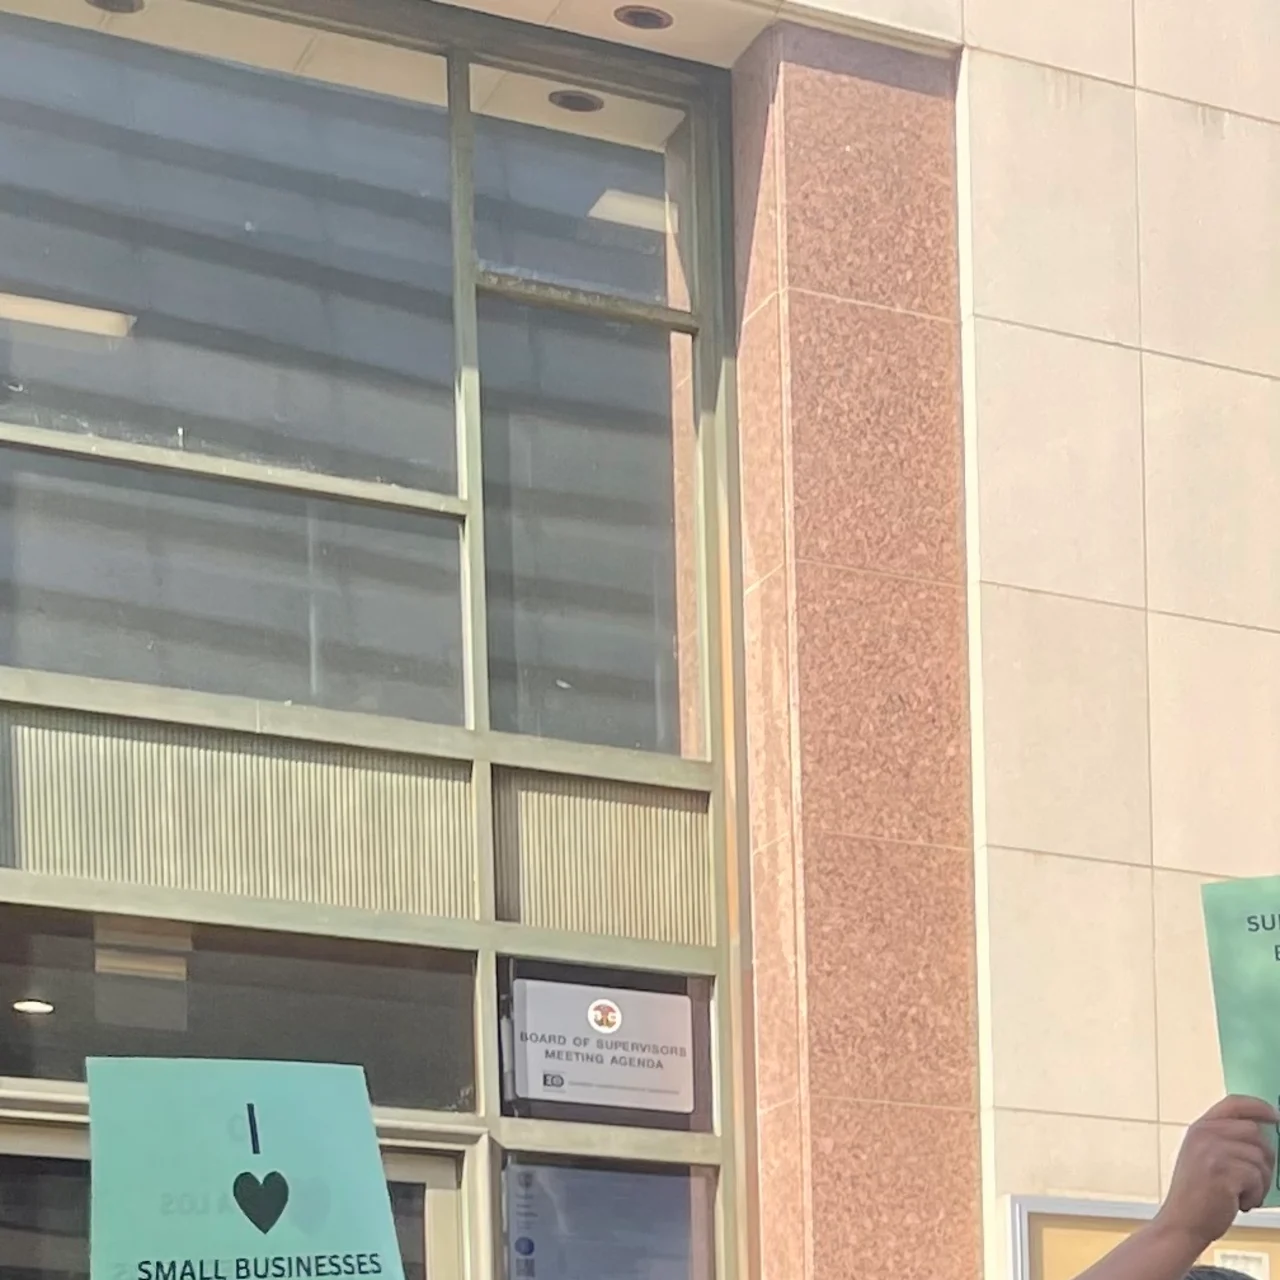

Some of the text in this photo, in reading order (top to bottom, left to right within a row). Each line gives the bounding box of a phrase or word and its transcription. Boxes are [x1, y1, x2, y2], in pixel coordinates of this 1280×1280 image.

[520, 1031, 688, 1058] BOARD OF SUPERVISORS
[544, 1049, 664, 1070] MEETING AGENDA
[246, 1102, 261, 1155] I
[235, 1253, 383, 1280] BUSINESSES
